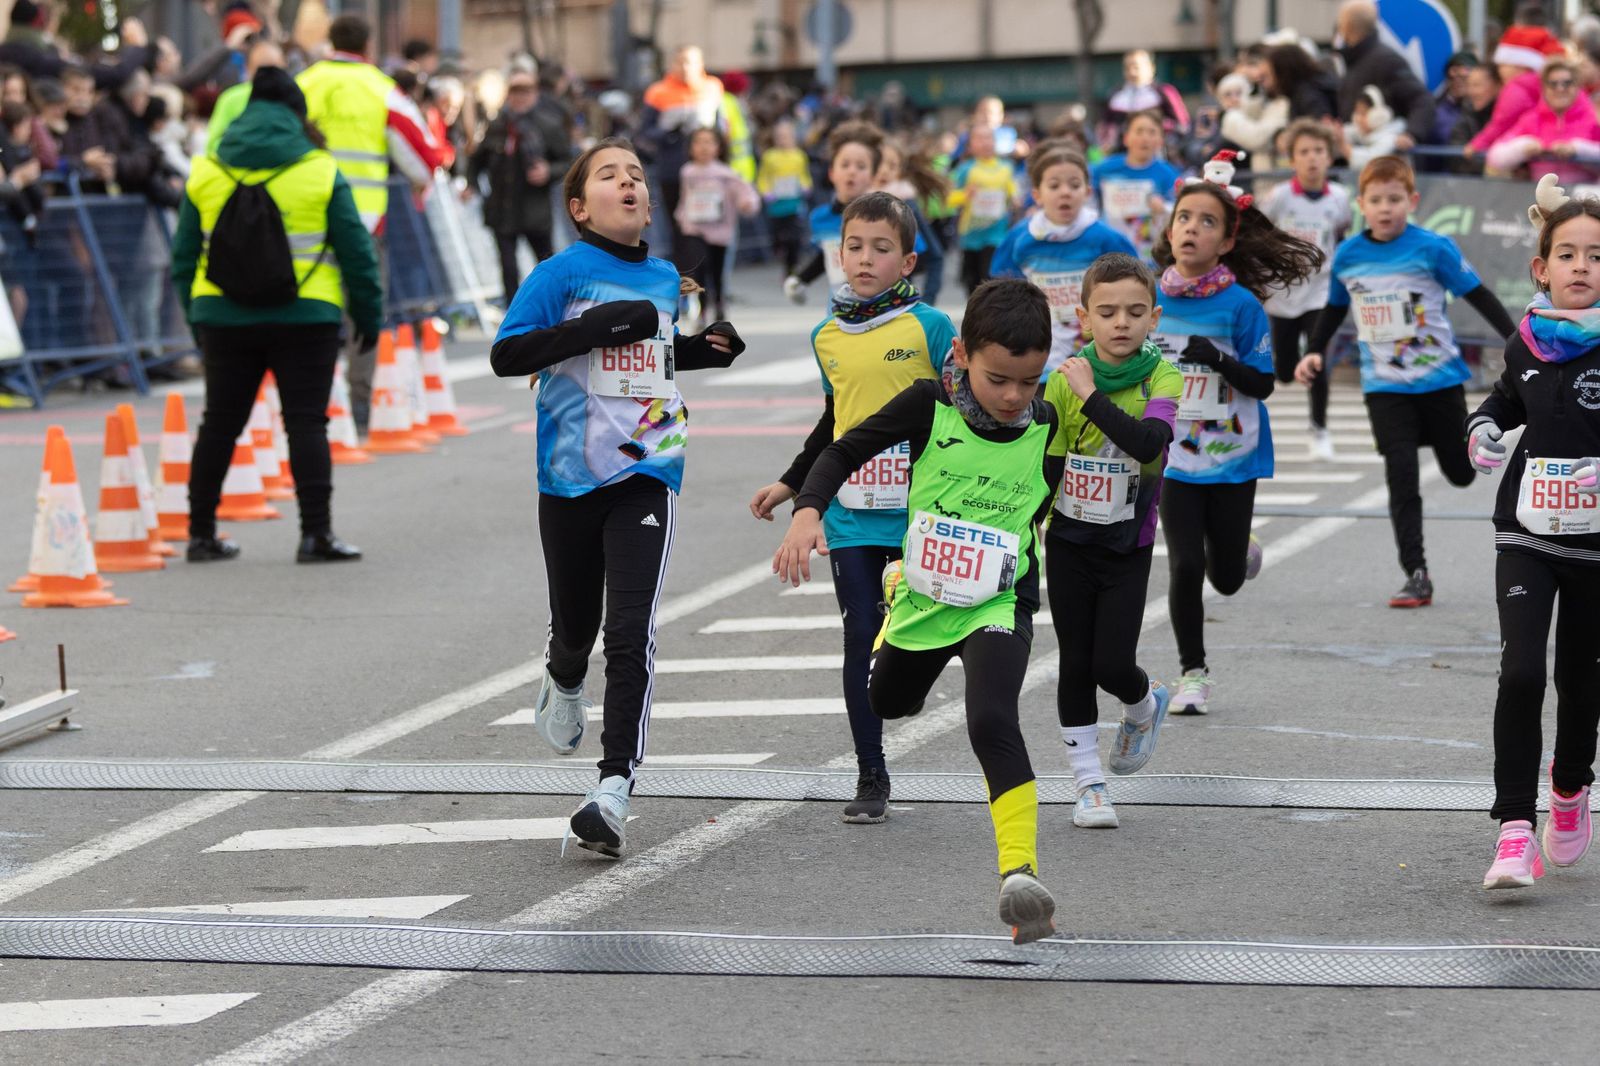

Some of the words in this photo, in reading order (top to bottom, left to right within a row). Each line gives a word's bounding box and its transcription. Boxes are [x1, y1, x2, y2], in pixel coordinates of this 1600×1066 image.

[1360, 305, 1393, 327] 6671
[601, 343, 657, 374] 6694
[1070, 458, 1131, 474] SETEL
[1064, 470, 1113, 503] 6821
[935, 521, 1008, 550] SETEL
[920, 537, 985, 582] 6851
[931, 573, 964, 586] BROWNIE
